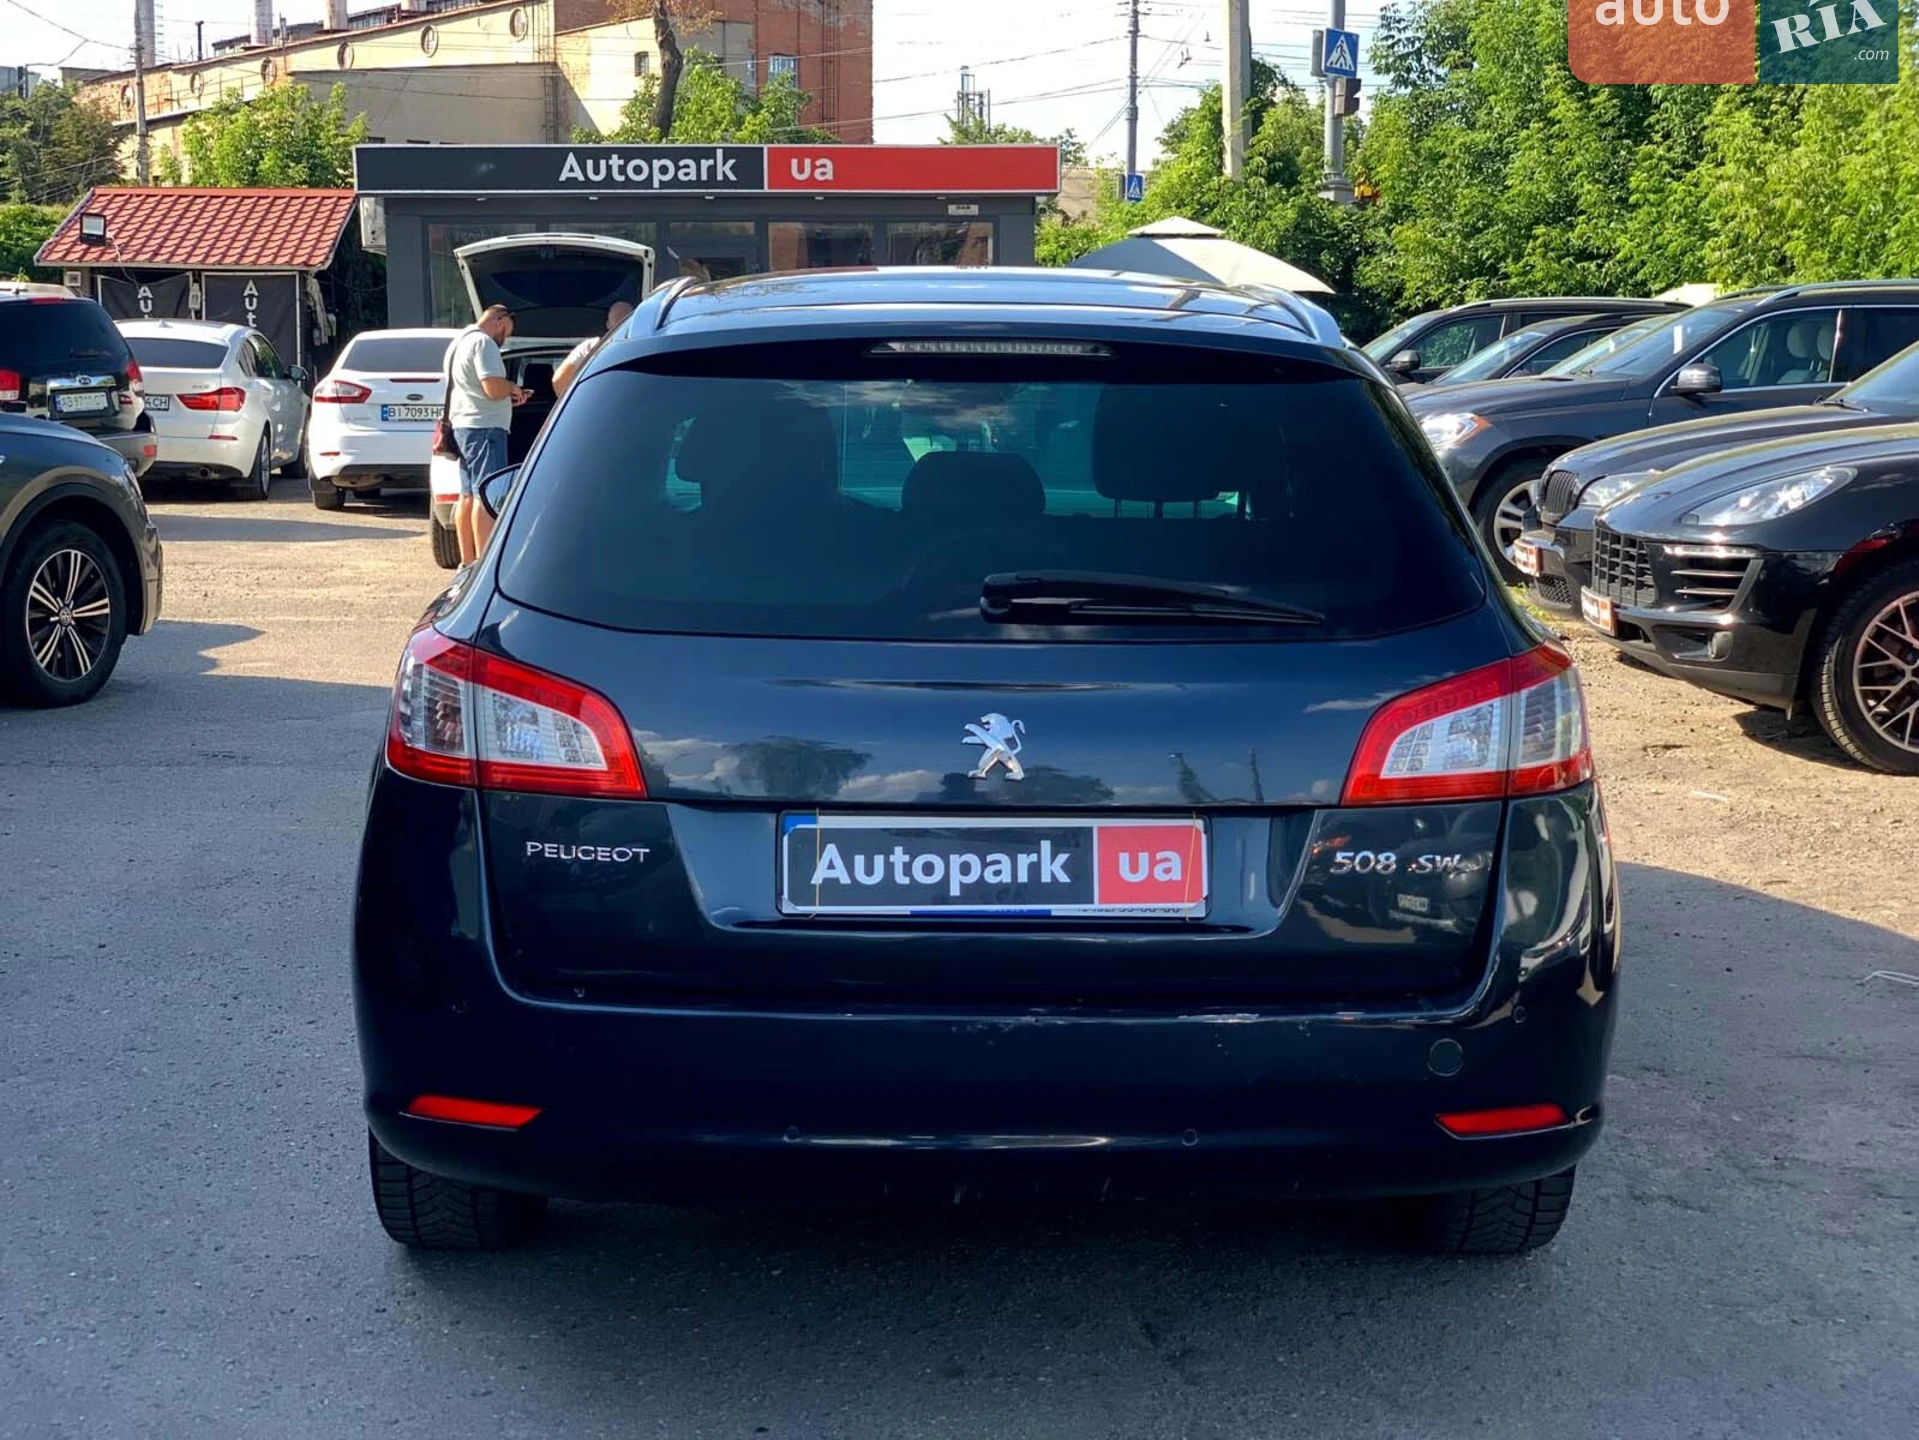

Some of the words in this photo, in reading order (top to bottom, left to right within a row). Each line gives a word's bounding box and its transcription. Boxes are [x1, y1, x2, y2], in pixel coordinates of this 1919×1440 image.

[558, 148, 738, 189] Autopark
[790, 158, 834, 181] ua
[525, 841, 650, 863] PEUGEOT
[810, 840, 1072, 896] Autopark
[1118, 851, 1182, 882] ua
[1330, 849, 1397, 875] 508
[1415, 853, 1461, 873] SW
